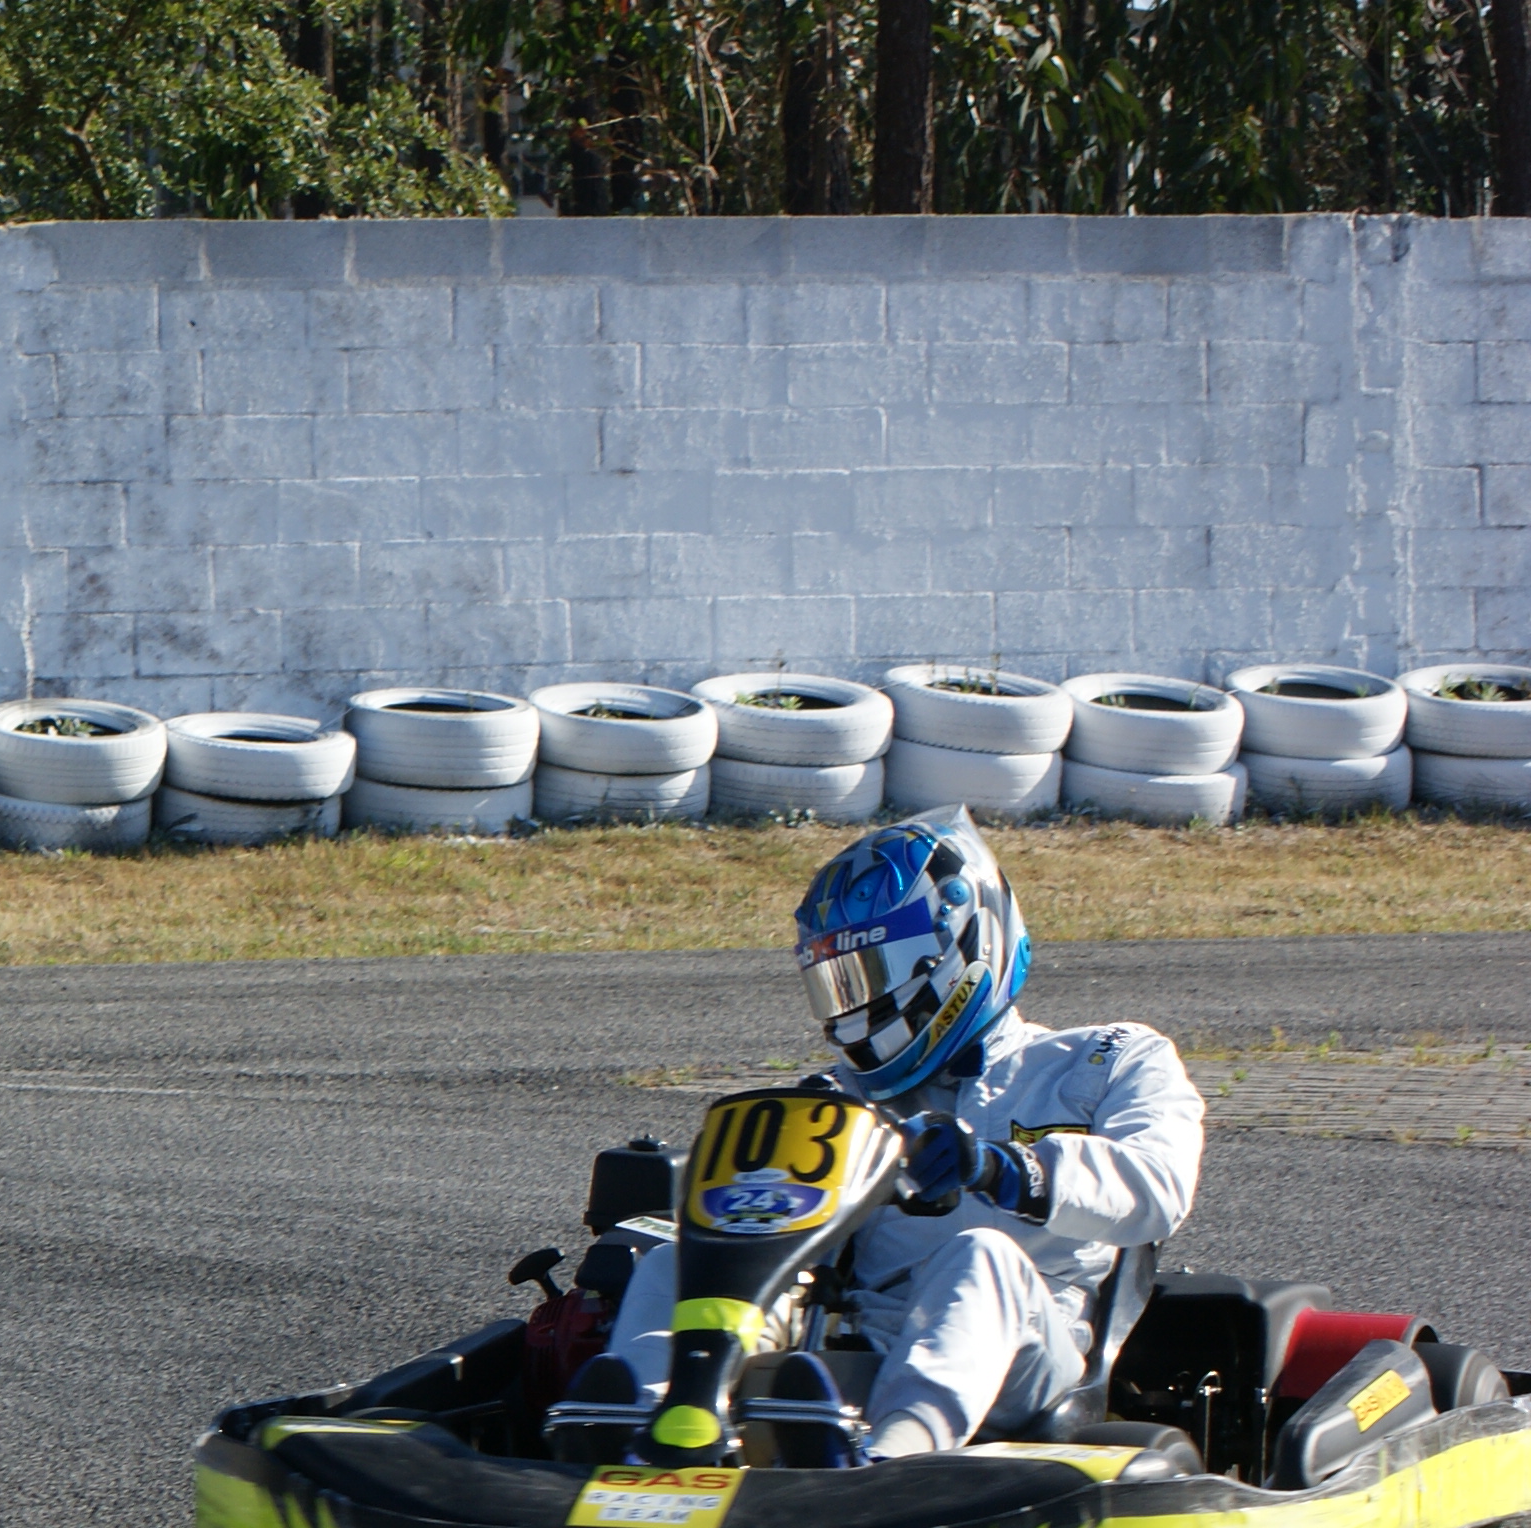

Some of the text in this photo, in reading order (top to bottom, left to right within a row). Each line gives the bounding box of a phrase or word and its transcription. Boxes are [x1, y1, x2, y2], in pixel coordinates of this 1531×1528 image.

[702, 1099, 847, 1183] 103
[597, 1470, 731, 1489] GAS
[589, 1491, 721, 1509] RACING
[604, 1507, 692, 1522] TEAM
